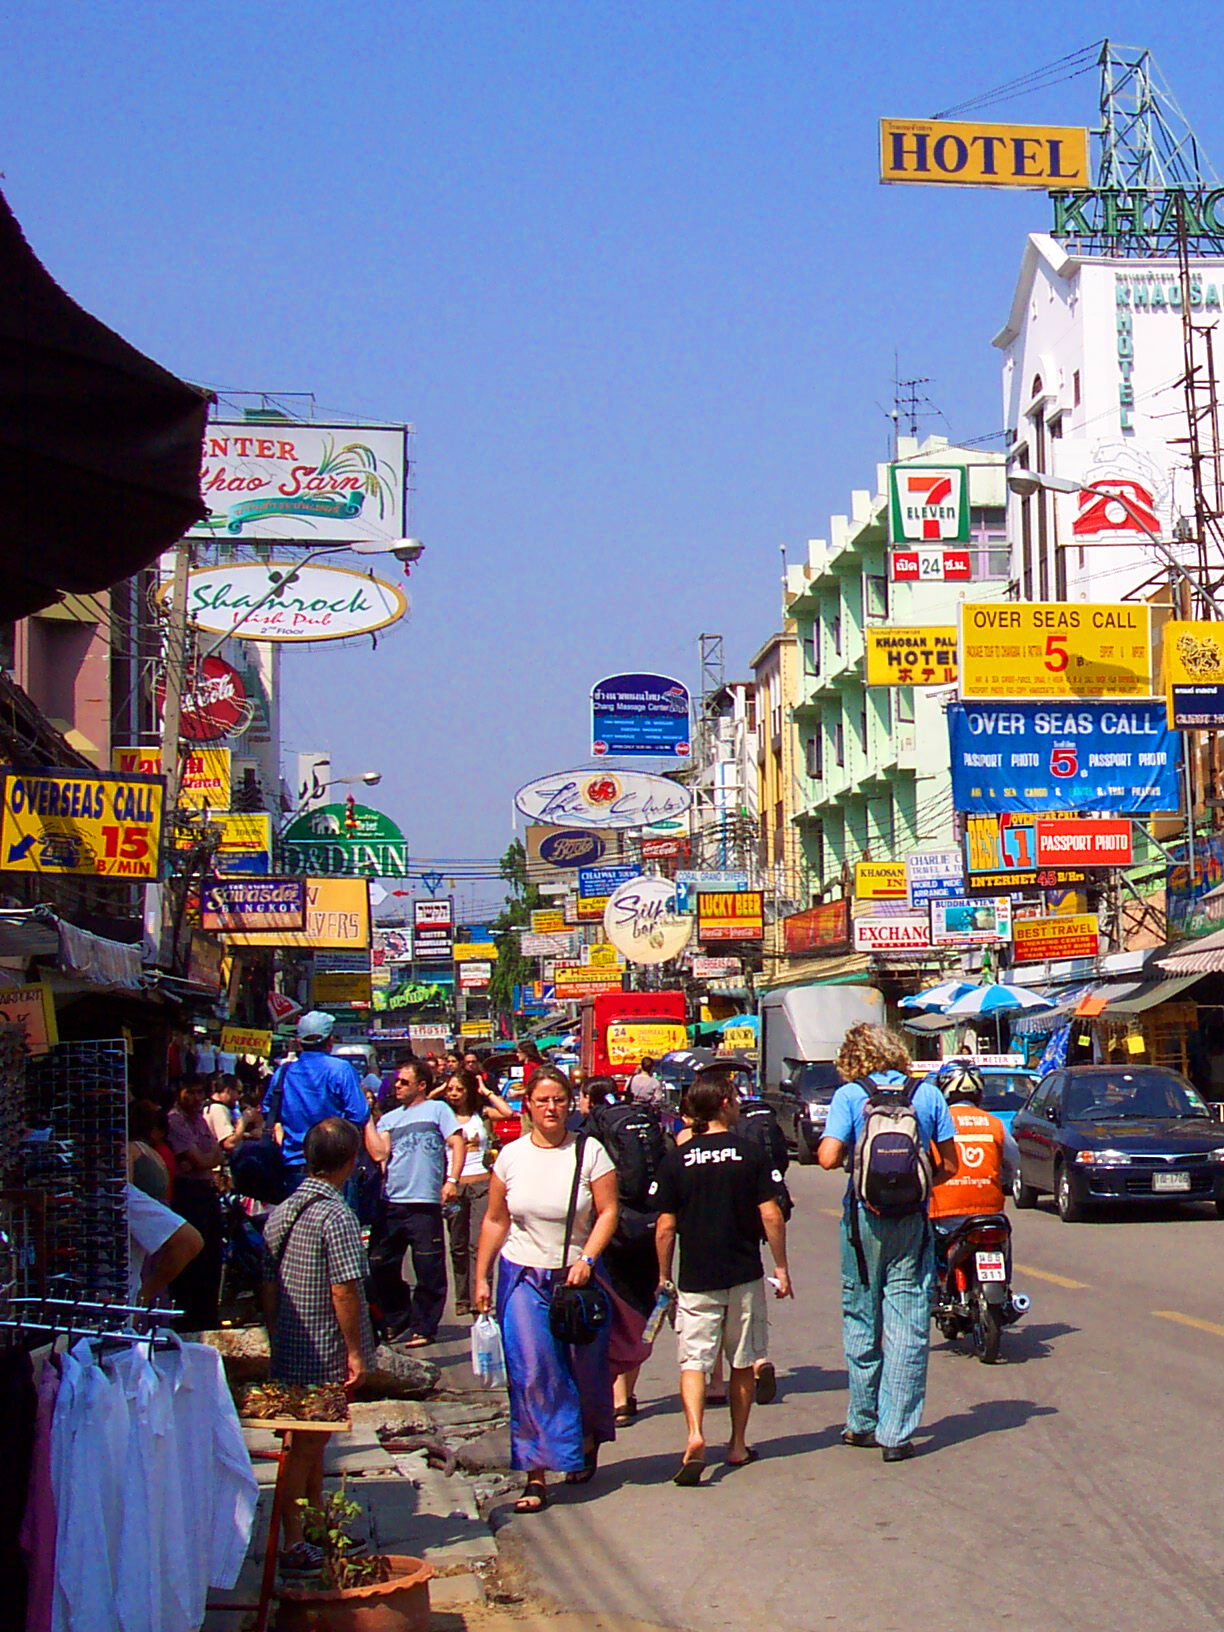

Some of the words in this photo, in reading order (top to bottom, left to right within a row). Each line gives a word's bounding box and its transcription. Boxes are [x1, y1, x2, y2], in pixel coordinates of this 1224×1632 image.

[889, 132, 1080, 178] HOTEL
[278, 466, 366, 496] Sarn
[895, 559, 918, 571] เปิด
[922, 559, 941, 574] 24
[192, 583, 372, 613] Shamrock
[232, 612, 285, 625] Irish
[292, 613, 331, 625] Pub
[974, 611, 1021, 628] OVER
[1033, 611, 1080, 628] SEAS
[1092, 612, 1137, 629] CALL
[876, 638, 927, 647] KHAOSAN
[1044, 635, 1069, 672] 5
[968, 714, 1025, 735] OVER
[1035, 713, 1093, 735] SEAS
[1101, 713, 1158, 735] CALL
[963, 753, 1002, 767] PASSPORT
[1011, 753, 1039, 767] PHOTO
[1050, 748, 1078, 778] 5
[1089, 753, 1131, 767] PASSPORT
[1139, 752, 1167, 766] PHOTO
[11, 780, 104, 819] OVERSEAS
[113, 785, 154, 823] CALL
[101, 826, 149, 860] 15
[967, 819, 998, 870] BEST
[1014, 830, 1031, 867] 1
[1040, 835, 1093, 851] PASSPORT
[1095, 834, 1128, 850] PHOTO
[96, 860, 150, 874] B/MIN
[351, 844, 408, 876] INN
[910, 854, 949, 866] CHARLIE
[860, 868, 904, 877] KHAOSAN
[970, 874, 1037, 887] INTERNET
[1037, 871, 1057, 886] 45
[1057, 872, 1085, 882] B/Hrs
[912, 881, 938, 889] WORLD
[221, 903, 300, 913] BANGKOK
[615, 895, 664, 924] Silk
[701, 893, 733, 916] LUCKY
[736, 893, 760, 915] BEER
[935, 901, 971, 909] BUDDHA
[975, 899, 996, 907] VIEW
[1017, 927, 1047, 939] BEST
[1050, 924, 1094, 935] TRAVEL
[223, 1035, 268, 1046] LAUNDRY
[981, 1271, 1002, 1280] 311
